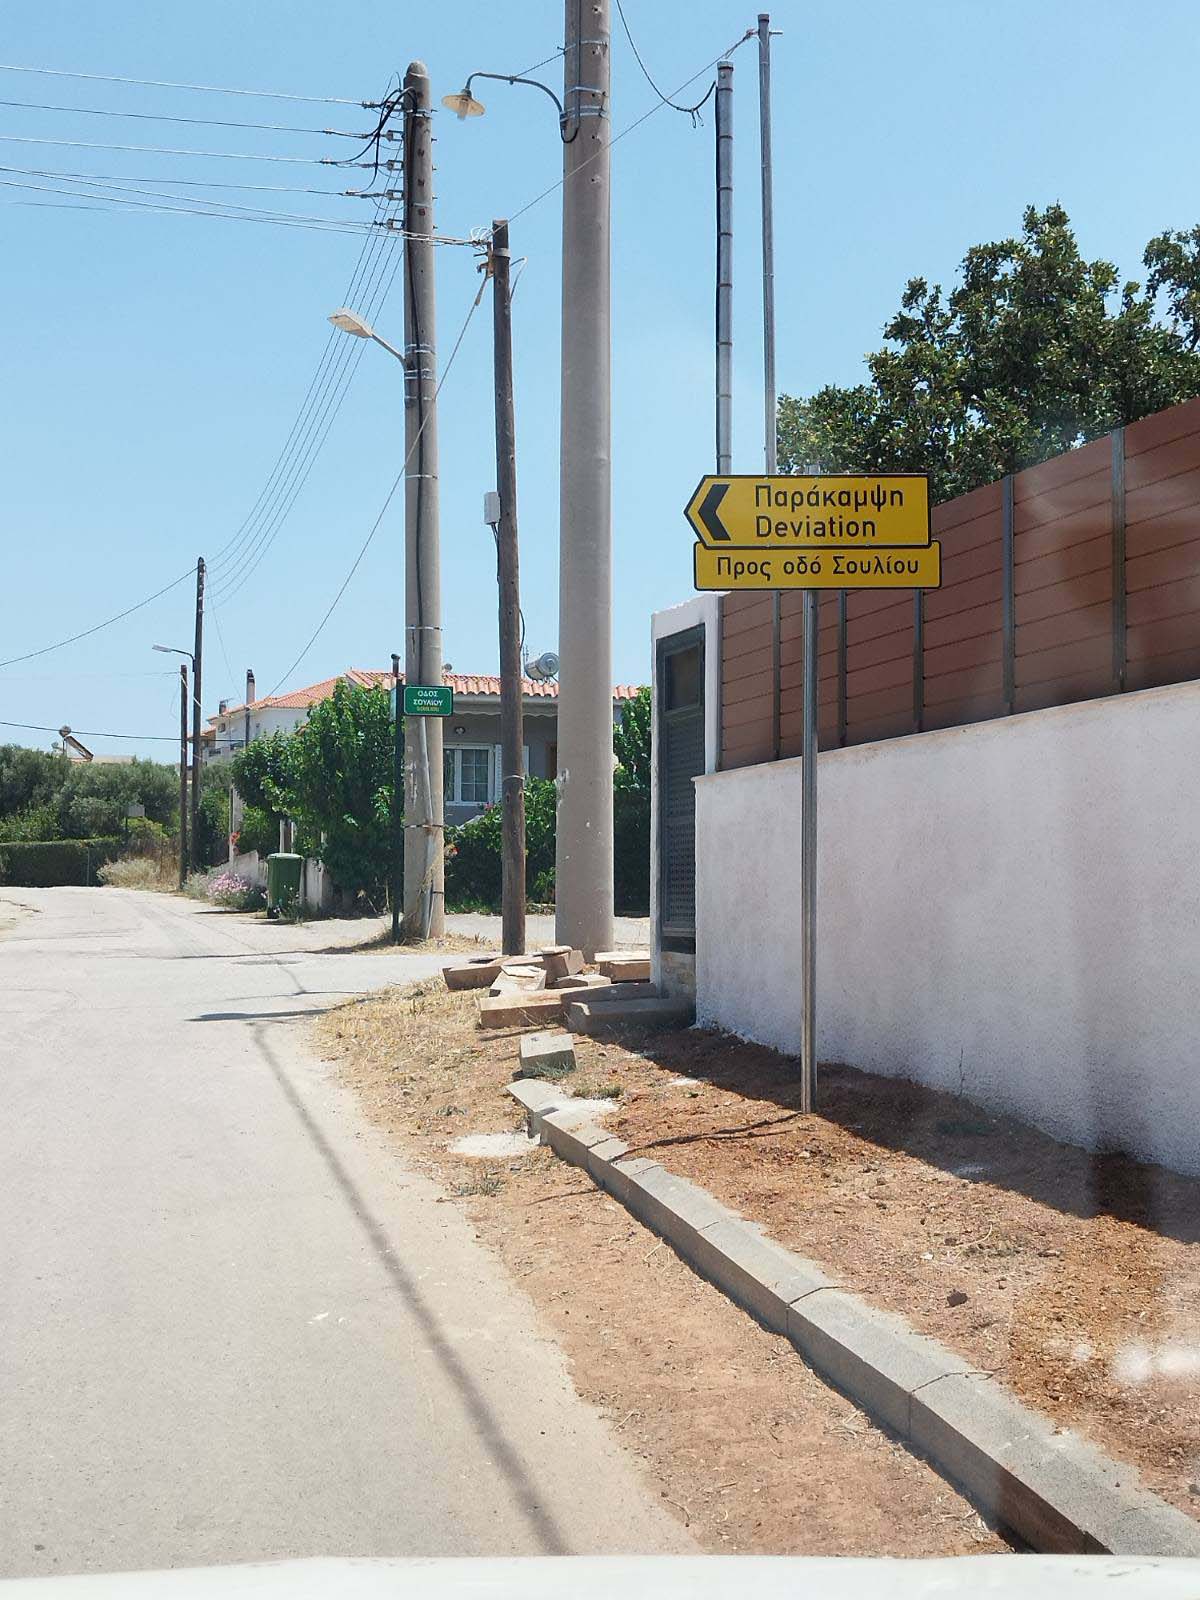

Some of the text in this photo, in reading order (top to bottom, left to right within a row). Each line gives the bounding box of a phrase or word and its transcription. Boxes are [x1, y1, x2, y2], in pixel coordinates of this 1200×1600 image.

[755, 484, 904, 512] Παράκαμψη
[756, 515, 876, 538] Deviation
[717, 555, 919, 580] Προς οδό Σουλίου
